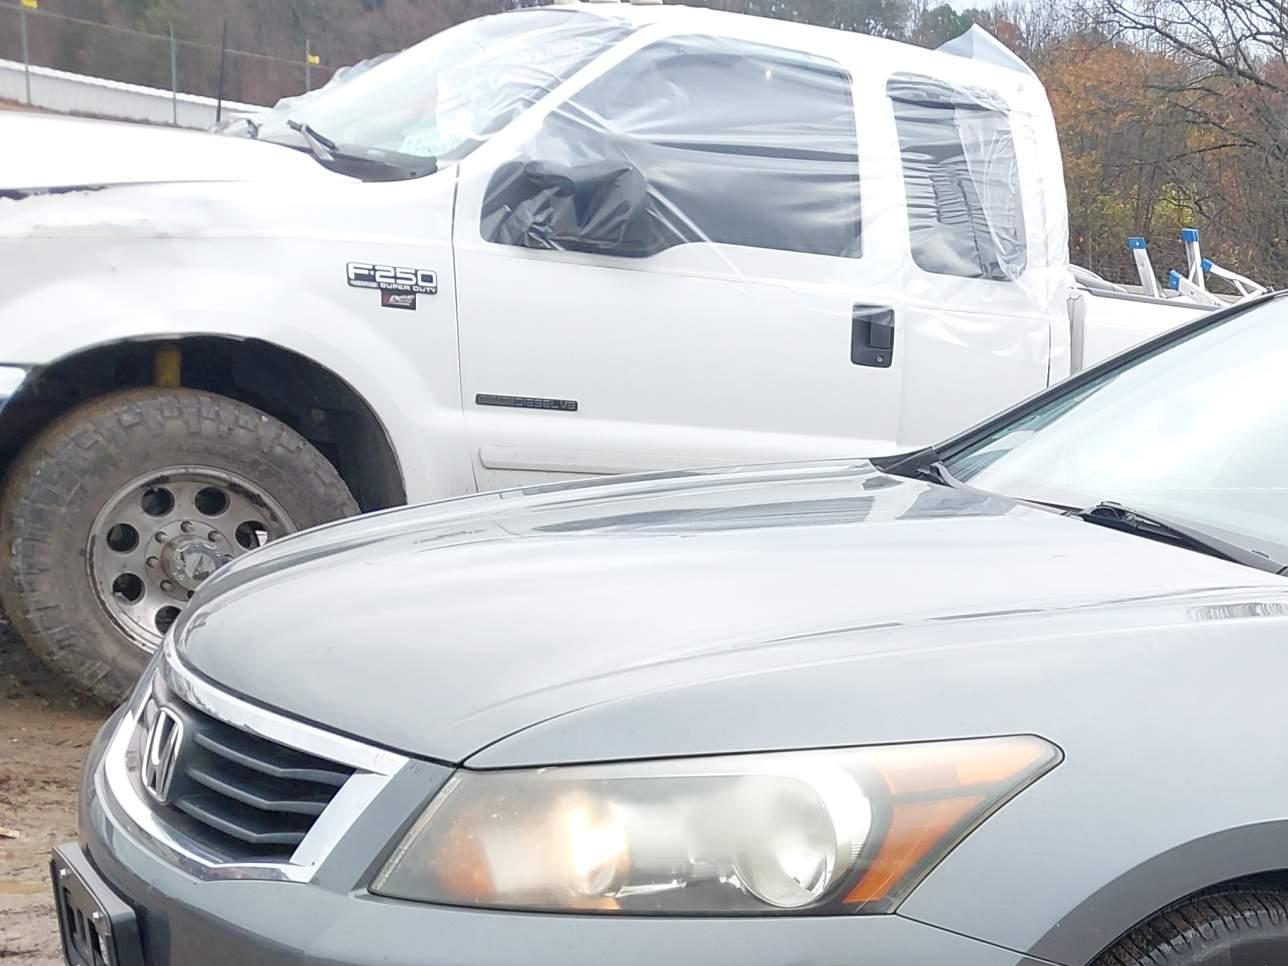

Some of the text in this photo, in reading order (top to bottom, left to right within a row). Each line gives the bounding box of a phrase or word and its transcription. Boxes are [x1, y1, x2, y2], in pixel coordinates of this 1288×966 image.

[346, 262, 437, 288] F-250
[380, 283, 411, 291] SUPER
[514, 397, 560, 409] DIESEL
